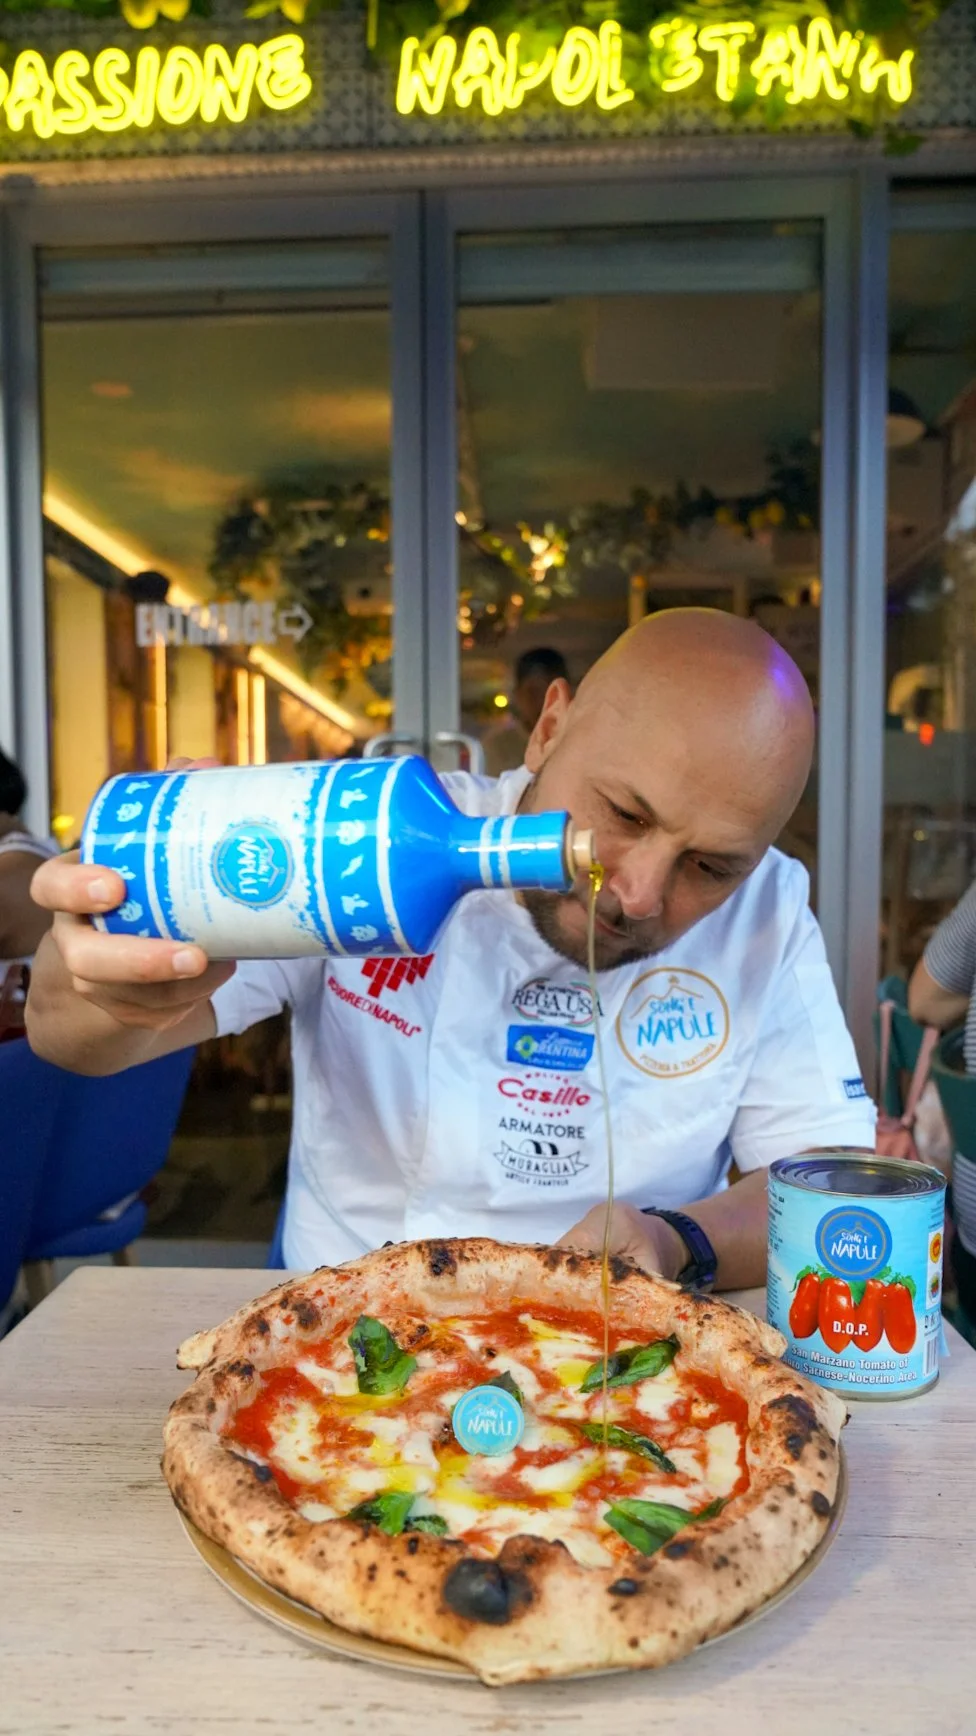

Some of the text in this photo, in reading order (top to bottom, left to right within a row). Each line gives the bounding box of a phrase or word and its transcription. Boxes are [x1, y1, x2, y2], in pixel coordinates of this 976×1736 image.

[135, 601, 278, 648] ENTRANCE
[511, 989, 561, 1012] REGA
[637, 1011, 718, 1048] NAPULE
[497, 1076, 591, 1106] Casillo
[498, 1116, 586, 1139] ARMATORE
[508, 1156, 571, 1175] MURAGLIA
[831, 1239, 878, 1260] NAPULE
[833, 1320, 869, 1336] D.O.P.
[791, 1344, 909, 1371] San Marzano Tomato of
[803, 1362, 896, 1385] Sarnese-Nocerino
[898, 1372, 918, 1383] Area
